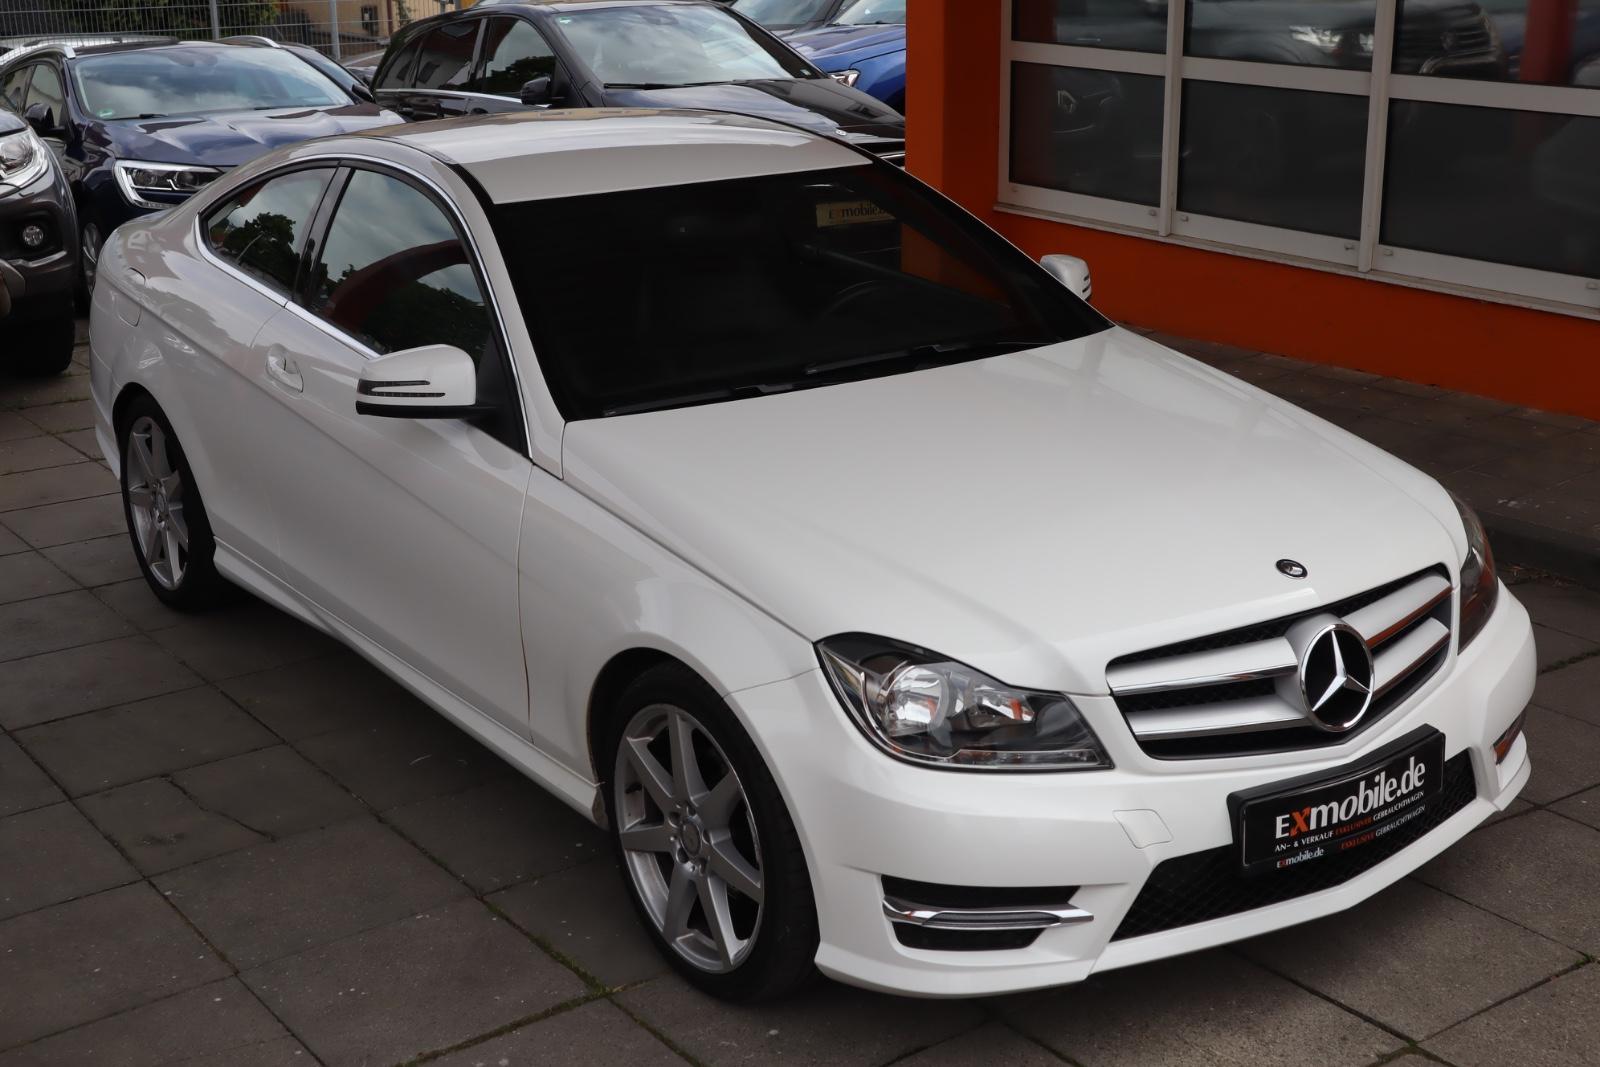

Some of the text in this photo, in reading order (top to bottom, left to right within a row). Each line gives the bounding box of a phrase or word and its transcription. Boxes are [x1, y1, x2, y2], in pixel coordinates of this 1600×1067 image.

[1275, 756, 1425, 839] EXmobile.de
[1301, 830, 1334, 845] VERKAUF
[1373, 791, 1424, 820] GEBRAUCHTWAGEN
[1375, 804, 1425, 837] GEBRAUCHTWAGEN
